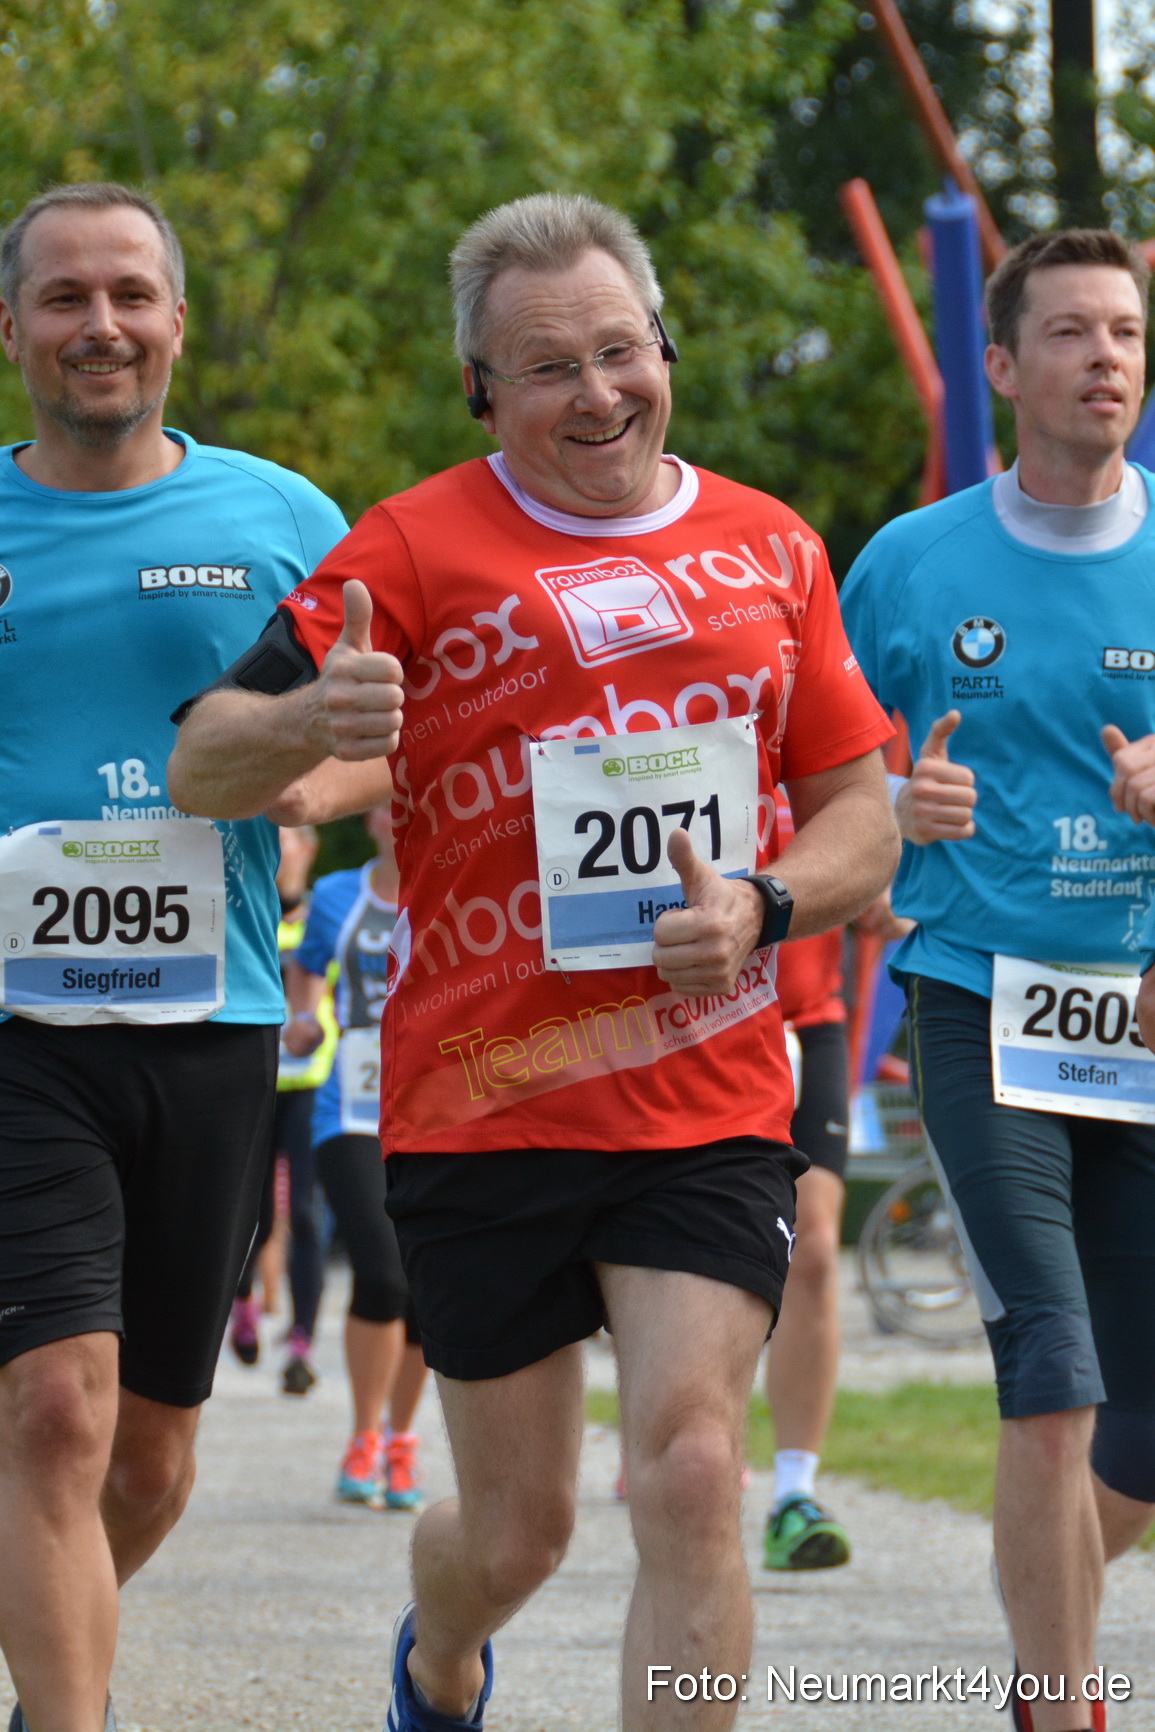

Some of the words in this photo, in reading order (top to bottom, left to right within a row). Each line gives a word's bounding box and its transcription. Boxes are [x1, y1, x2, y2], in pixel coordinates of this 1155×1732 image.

[139, 564, 252, 591] BOCK
[547, 561, 644, 590] raumbox
[139, 590, 175, 600] inspired
[178, 589, 189, 598] by
[192, 590, 217, 598] smart
[220, 591, 255, 600] concepts
[957, 618, 1002, 637] BMW
[1103, 647, 1155, 672] BO
[952, 676, 1005, 689] PARTL
[1102, 670, 1134, 680] inspired
[1136, 673, 1146, 681] by
[458, 666, 548, 719] outdoor
[952, 689, 1005, 700] Neumarkt
[627, 747, 700, 775] BOCK
[97, 758, 161, 800] 18.
[628, 774, 654, 782] inspired
[663, 770, 679, 778] smart
[574, 794, 722, 879] 2071
[1053, 814, 1108, 852] 18.
[85, 840, 161, 858] BOCK
[1050, 875, 1144, 899] Stadtlauf
[32, 885, 190, 945] 2095
[62, 966, 161, 993] Siegfried
[413, 972, 497, 1017] wohnen
[663, 1021, 706, 1050] schenken
[710, 1007, 743, 1029] wohnen
[437, 995, 656, 1101] Team
[359, 1061, 379, 1094] 2
[1058, 1061, 1118, 1086] Stefan
